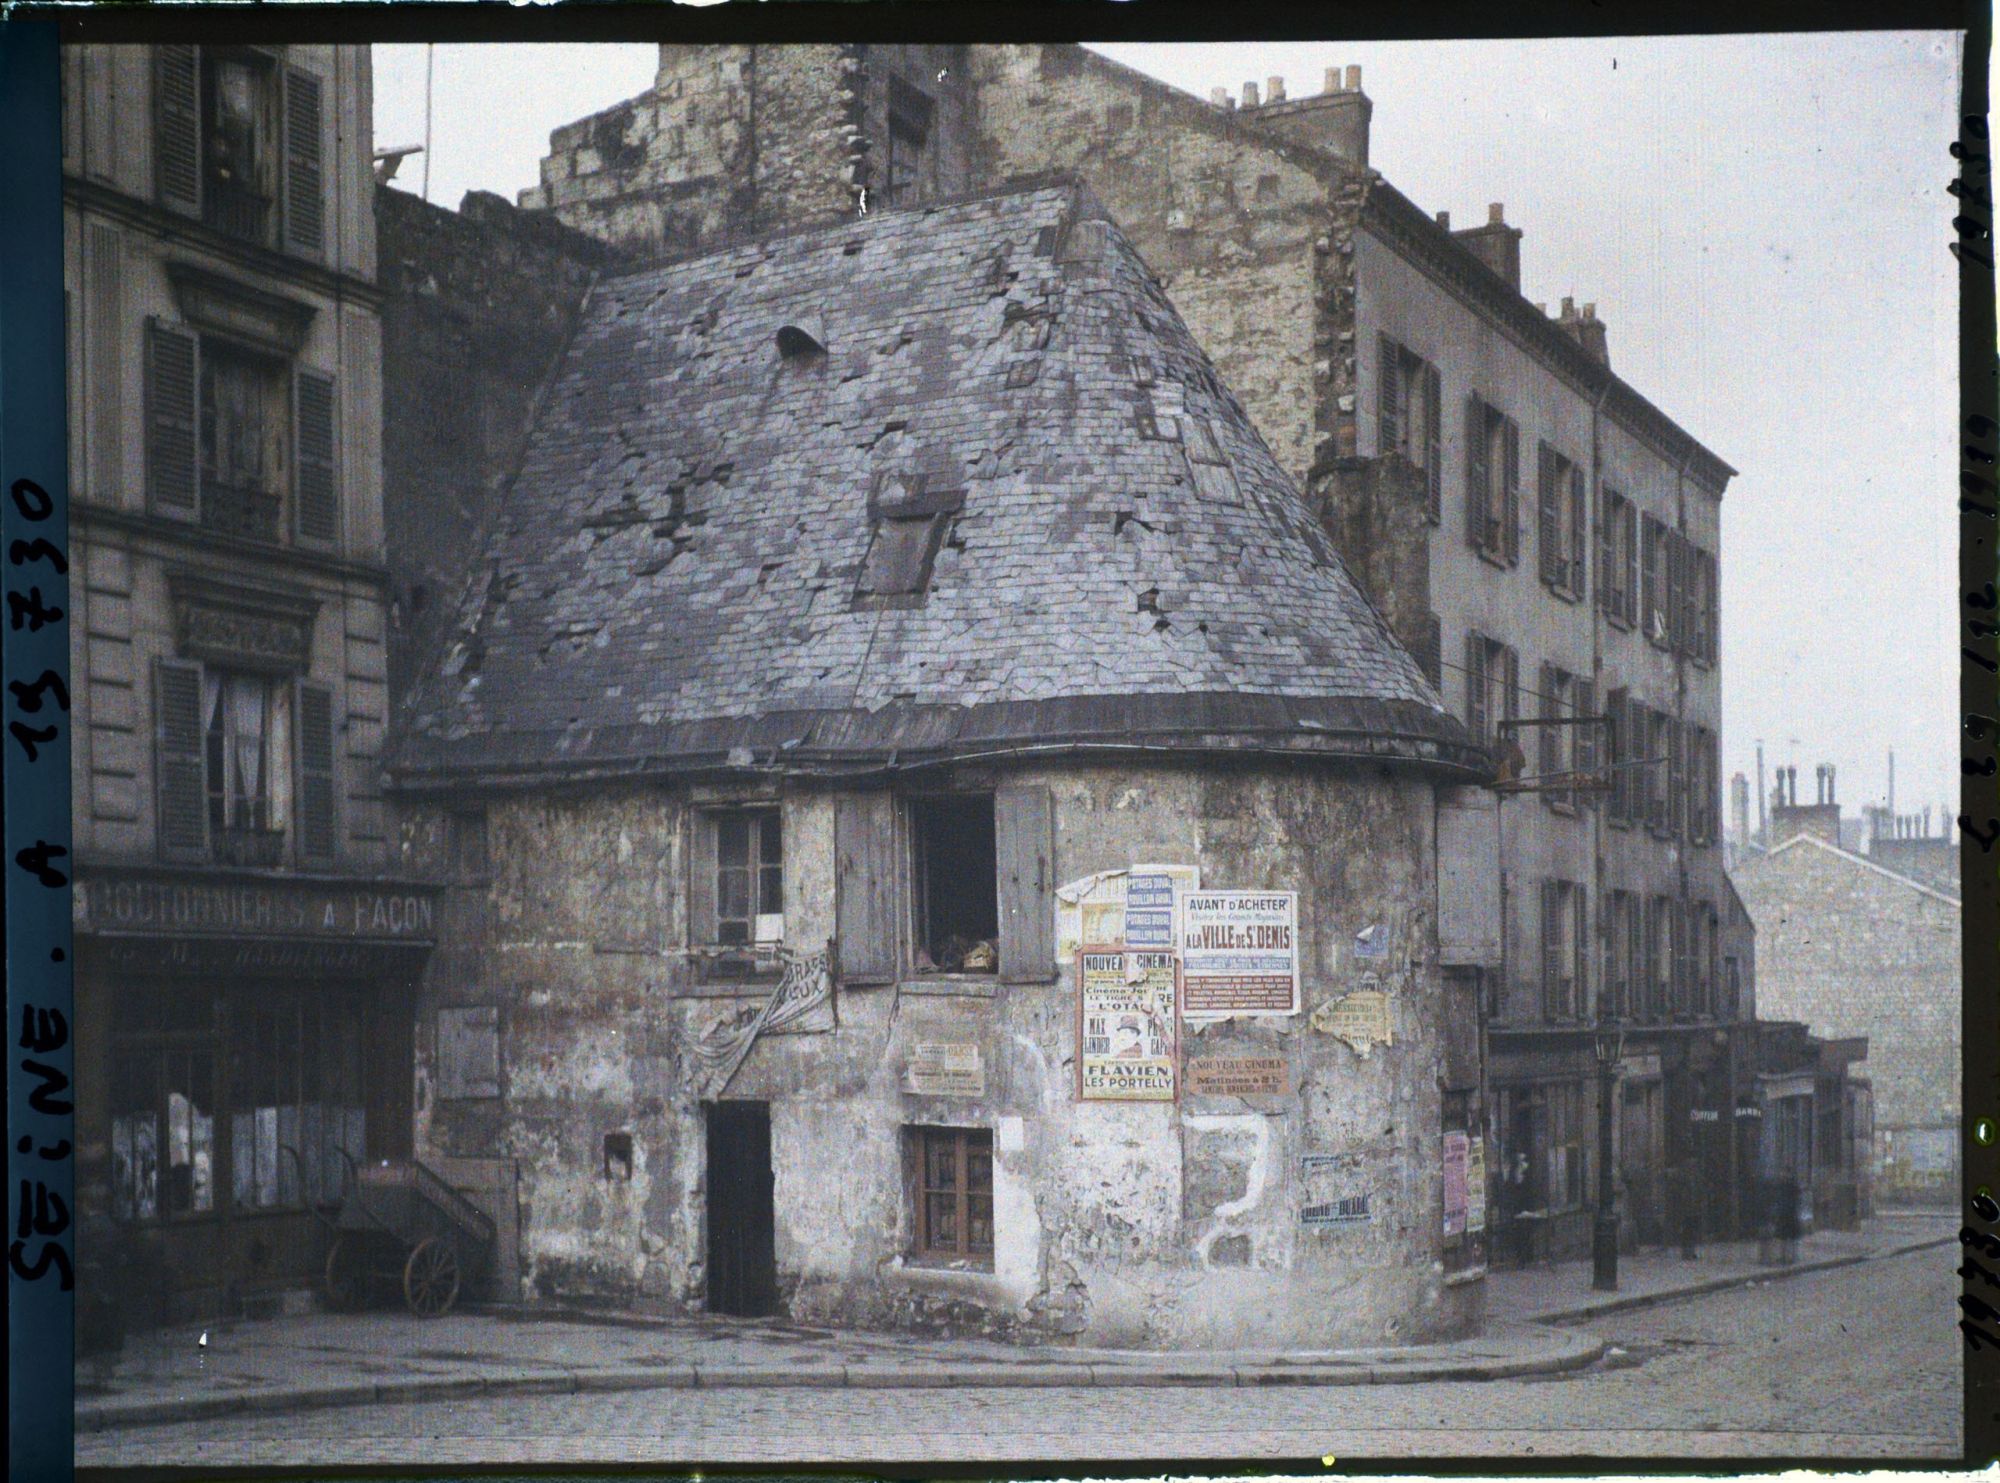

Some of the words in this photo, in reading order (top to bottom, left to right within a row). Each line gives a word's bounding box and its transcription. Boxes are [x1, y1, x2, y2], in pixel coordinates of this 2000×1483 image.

[14, 838, 69, 889] A
[1190, 899, 1226, 910] AVANT
[1202, 925, 1235, 949] VILLE
[1236, 934, 1246, 949] DE
[1089, 1018, 1106, 1035] MAX
[1088, 1066, 1168, 1076] FLAVIEN
[1196, 1060, 1242, 1070] NOUVEAU
[1084, 1077, 1104, 1088] LES
[1109, 1077, 1173, 1089] PORTELLY
